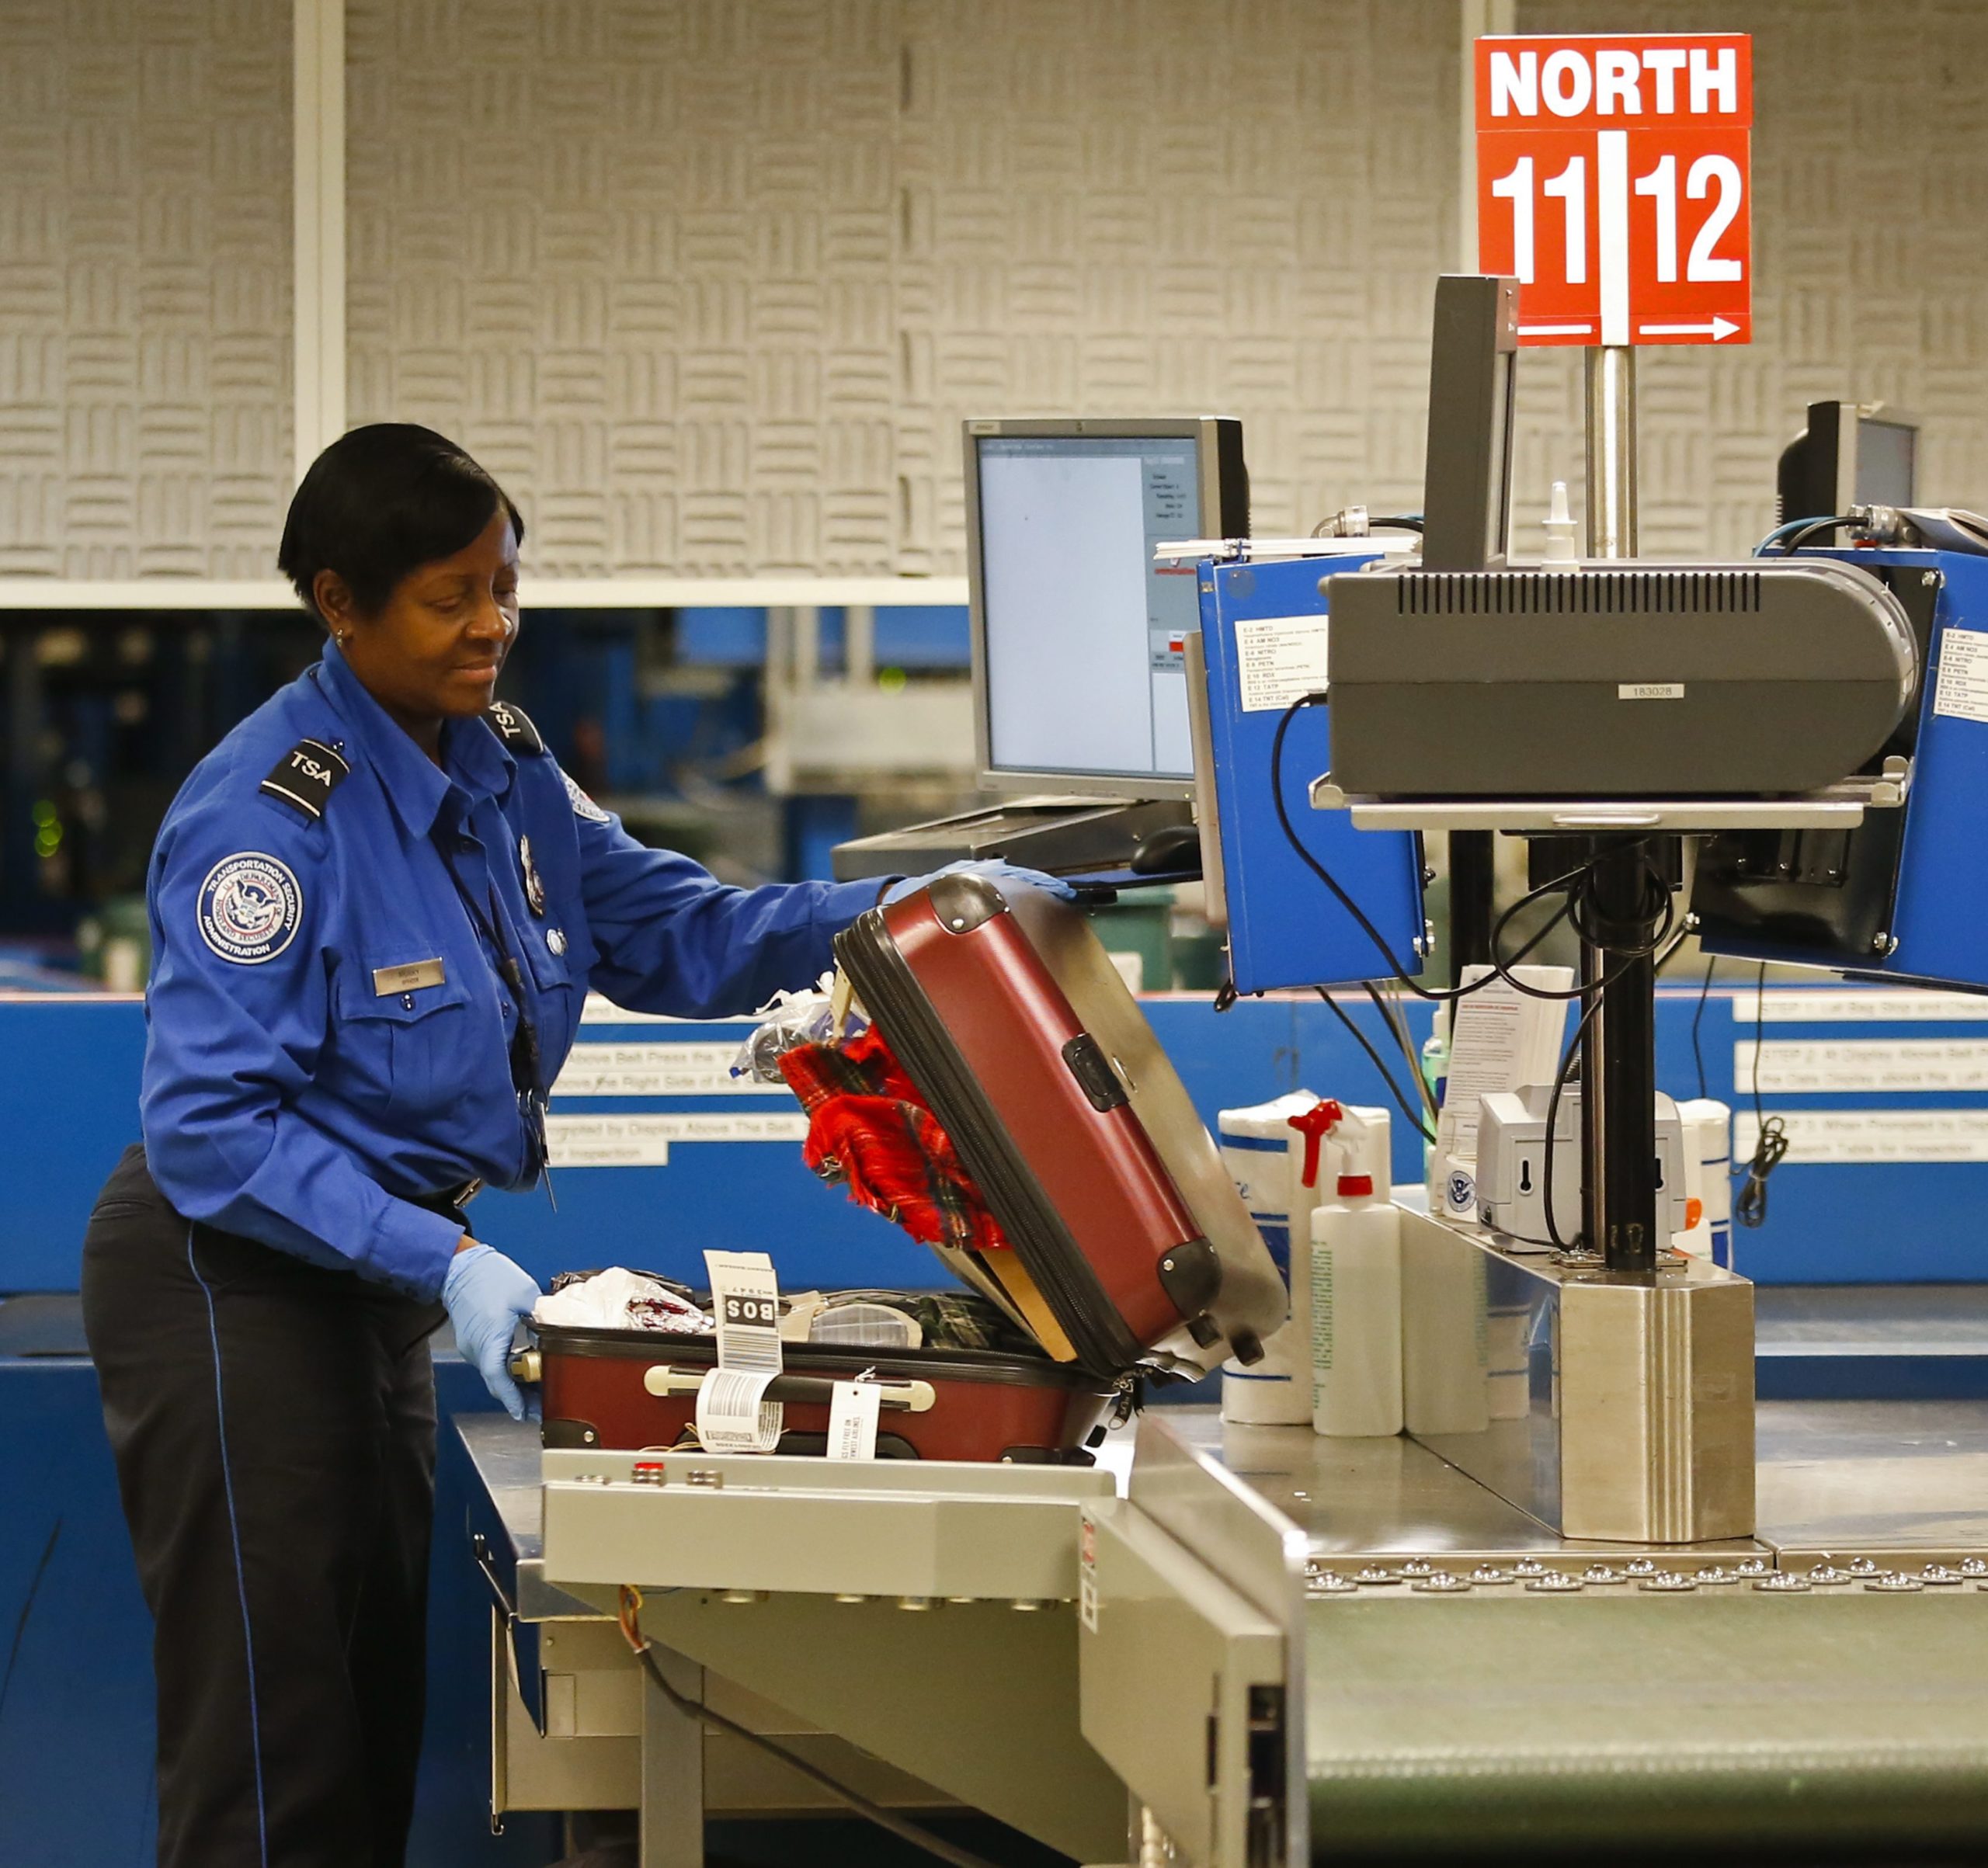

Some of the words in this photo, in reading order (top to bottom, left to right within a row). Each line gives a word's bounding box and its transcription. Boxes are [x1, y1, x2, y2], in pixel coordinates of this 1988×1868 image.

[1490, 48, 1736, 117] NORTH
[1492, 156, 1586, 284] 11
[1635, 155, 1742, 283] 12
[1634, 687, 1672, 696] 183028
[488, 702, 521, 738] TSA
[290, 750, 332, 786] TSA
[207, 860, 285, 893] TRANSPORTATION
[283, 881, 295, 931] SECURITY
[203, 915, 270, 956] ADMINISTRATION
[238, 924, 275, 942] SECURITY
[727, 1300, 773, 1321] BOS
